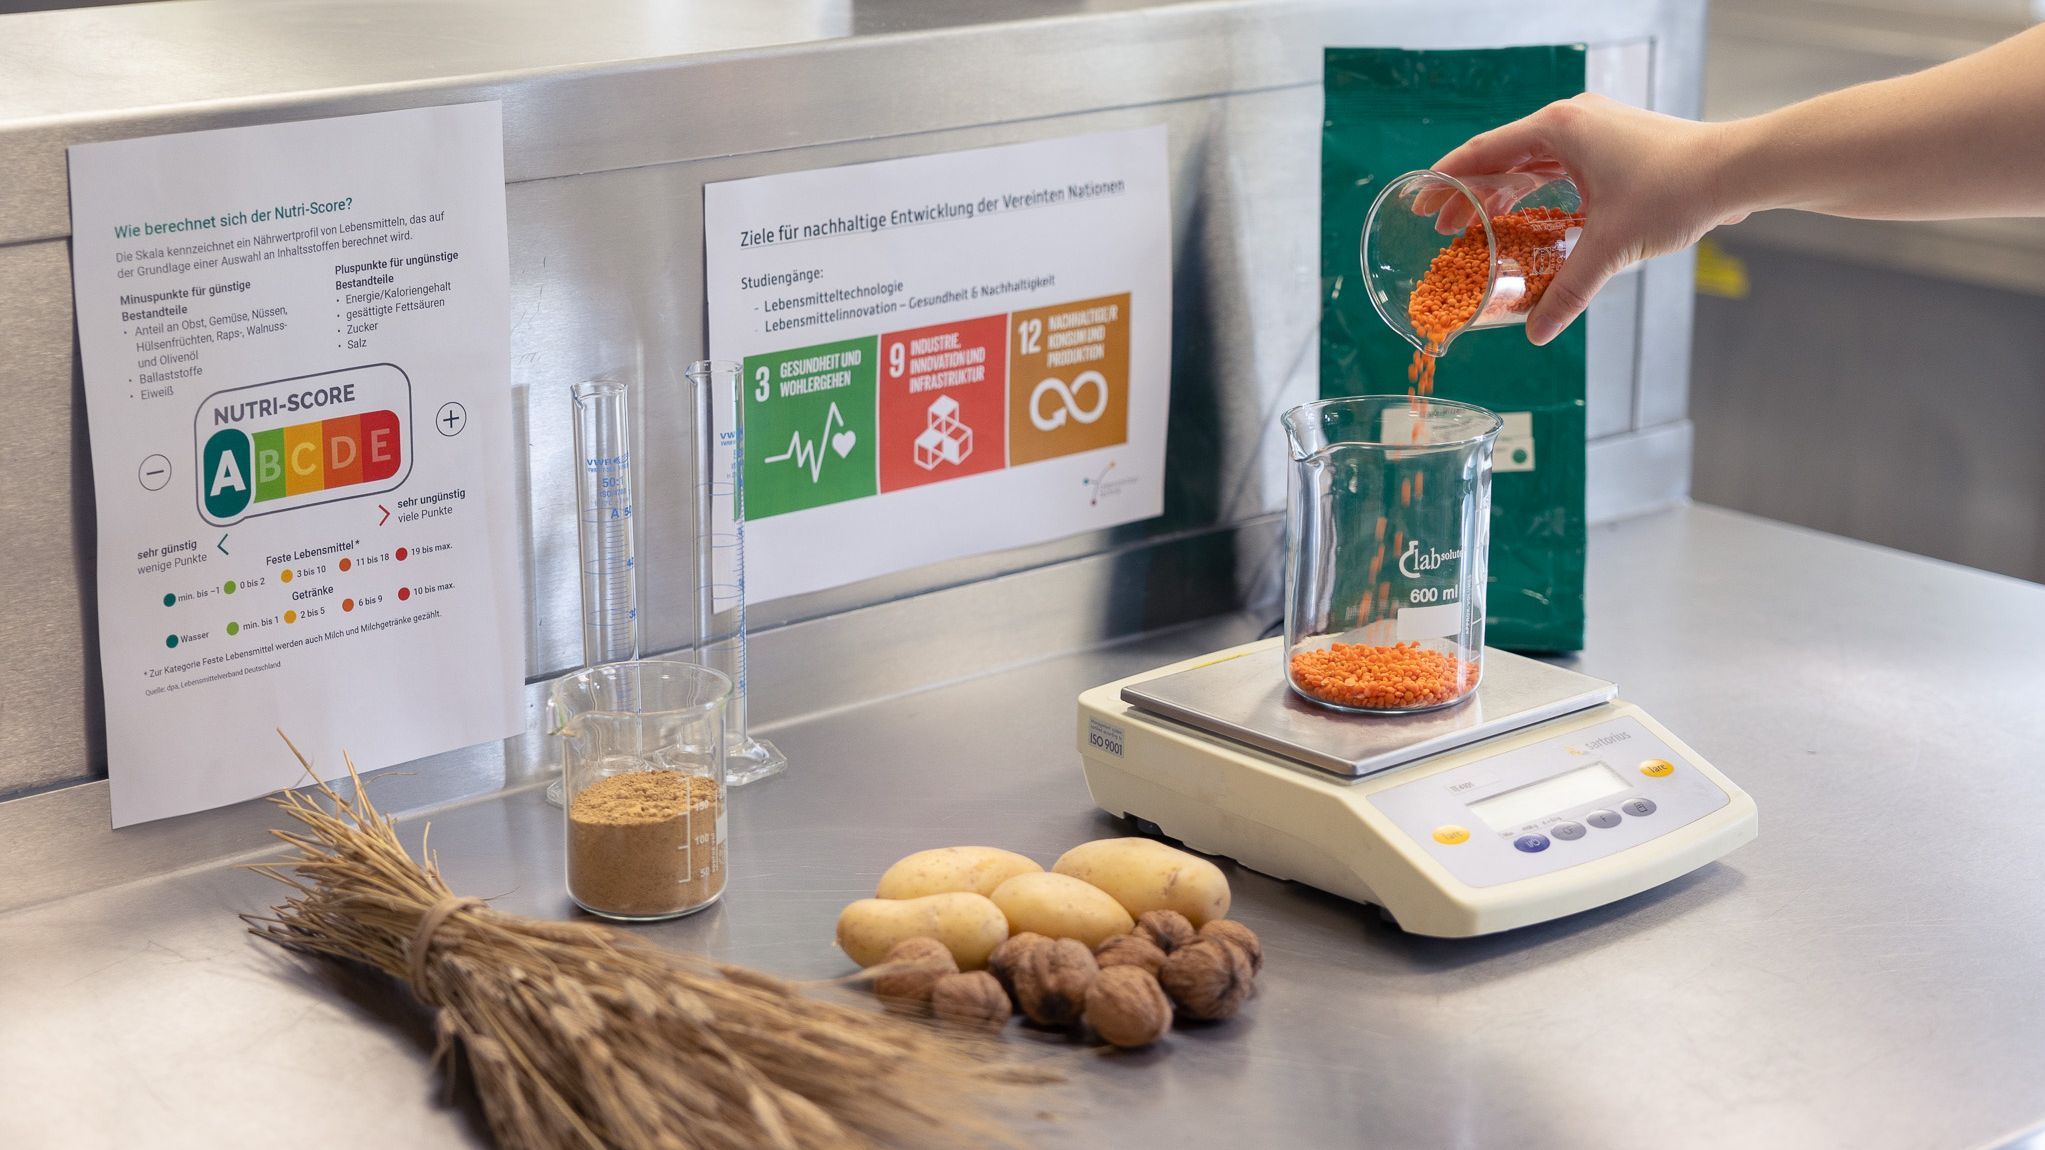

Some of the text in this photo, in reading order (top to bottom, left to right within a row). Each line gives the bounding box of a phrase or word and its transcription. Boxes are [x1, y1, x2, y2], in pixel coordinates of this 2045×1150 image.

[114, 198, 352, 238] Wie berechnet sich der Nutri-Score?
[740, 179, 1124, 246] Ziele für nachhaltige Entwicklung der Vereinten Nationen
[116, 211, 444, 263] Die Skala kennzeichnet ein Nährwertprofil von Lebensmitteln, das auf
[118, 230, 412, 278] der Grundlage einer Auswahl an Inhaltsstoffen berechnet wird.
[335, 251, 458, 274] Pluspunkte für ungünstige
[336, 274, 394, 290] Bestandteile
[741, 268, 824, 290] Studiengänge:
[120, 280, 250, 306] Minuspunkte für günstige
[346, 282, 451, 304] Energie/Kaloriengehalt
[764, 280, 904, 312] Lebensmitteltechnologie
[765, 301, 896, 332] Lebensmittelinnovation
[909, 286, 968, 309] Gesundheit
[980, 274, 1055, 296] Nachhaltigkeit
[122, 304, 188, 322] Bestandteile
[346, 298, 445, 321] gesättigte Fettsäuren
[135, 306, 288, 336] Anteil an Obst, Gemüse, Nüssen,
[347, 322, 378, 334] Zucker
[136, 322, 287, 352] Hülsenfrüchten, Raps-, Walnuss-
[348, 338, 367, 349] Salz
[1018, 318, 1042, 355] 12
[138, 350, 199, 368] und Olivenöl
[780, 350, 862, 378] GESUNDHEIT UND
[890, 342, 904, 378] 9
[910, 347, 986, 374] INNOVATION UND
[140, 365, 202, 384] Ballaststoffe
[755, 366, 770, 402] 3
[780, 370, 851, 398] WOHLERGEHEN
[910, 366, 984, 394] INFRASTRUKTUR
[141, 386, 174, 400] Eiweiß
[214, 384, 356, 426] NUTRI-SCORE
[210, 428, 391, 497] A B C D E
[398, 488, 466, 508] sehr ungünstig
[398, 506, 452, 522] viele Punkte
[138, 540, 197, 560] sehr günstig
[266, 552, 292, 566] Feste
[411, 543, 452, 556] 19 bis max.
[138, 554, 208, 574] wenige Punkte
[356, 554, 390, 566] 11 bis 18
[297, 566, 326, 578] 3 bis 10
[247, 580, 258, 588] bis
[260, 578, 266, 586] 2
[414, 582, 456, 596] 10 bis max.
[178, 594, 195, 602] min.
[197, 590, 208, 598] bis
[292, 586, 334, 601] Getränke
[358, 594, 383, 606] 6 bis 9
[1410, 584, 1458, 603] 600 ml
[307, 608, 318, 617] bis
[242, 622, 259, 630] min.
[261, 618, 272, 627] bis
[149, 610, 442, 678] Zur Kategorie Feste Lebensmittel werden auch Milch und Milchgetränke gezählt.
[181, 632, 210, 643] Wasser
[180, 668, 243, 688] Lebensmittelverband
[244, 661, 280, 675] Deutschland
[1090, 733, 1122, 755] ISO 9001
[1586, 732, 1631, 750] sartorius
[695, 833, 709, 844] 100
[700, 867, 710, 878] 50
